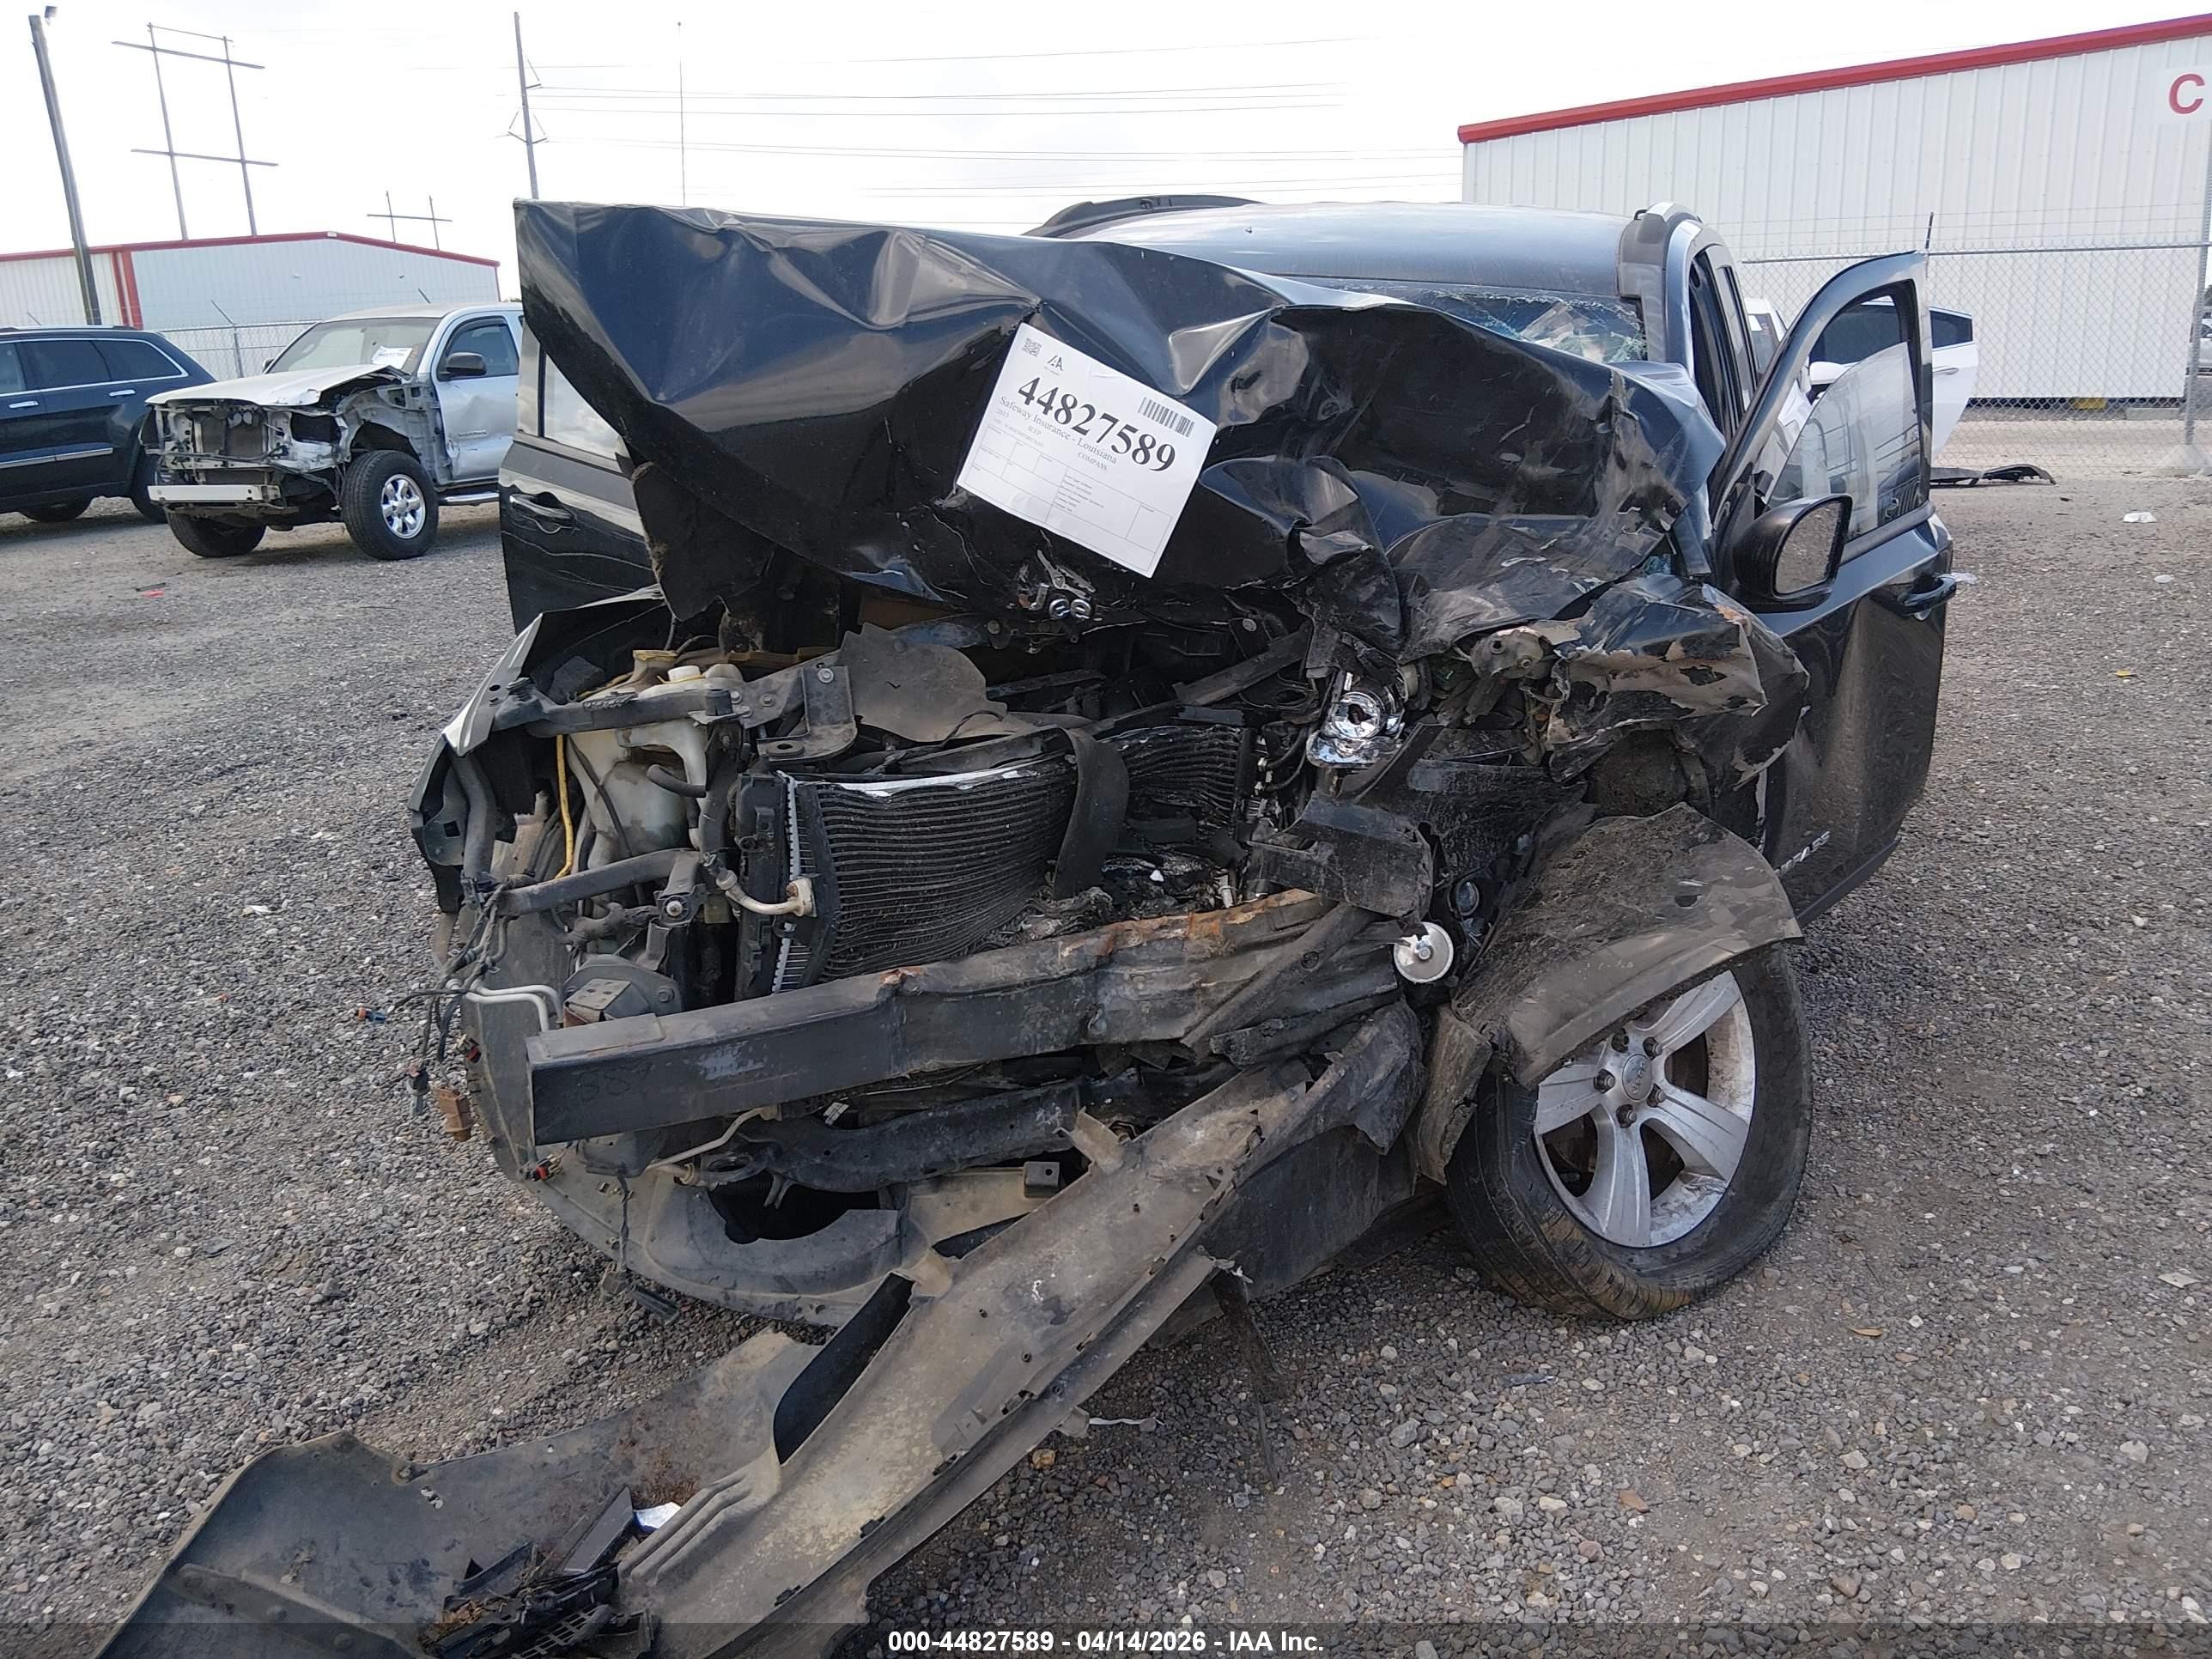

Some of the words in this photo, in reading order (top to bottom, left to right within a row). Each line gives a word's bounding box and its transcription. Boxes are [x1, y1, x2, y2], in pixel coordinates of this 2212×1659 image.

[2169, 73, 2205, 115] C
[1000, 396, 1031, 420] Safeway
[1033, 415, 1071, 441] Insurance
[1077, 437, 1117, 465] Louisiana
[1018, 377, 1176, 471] 44827589
